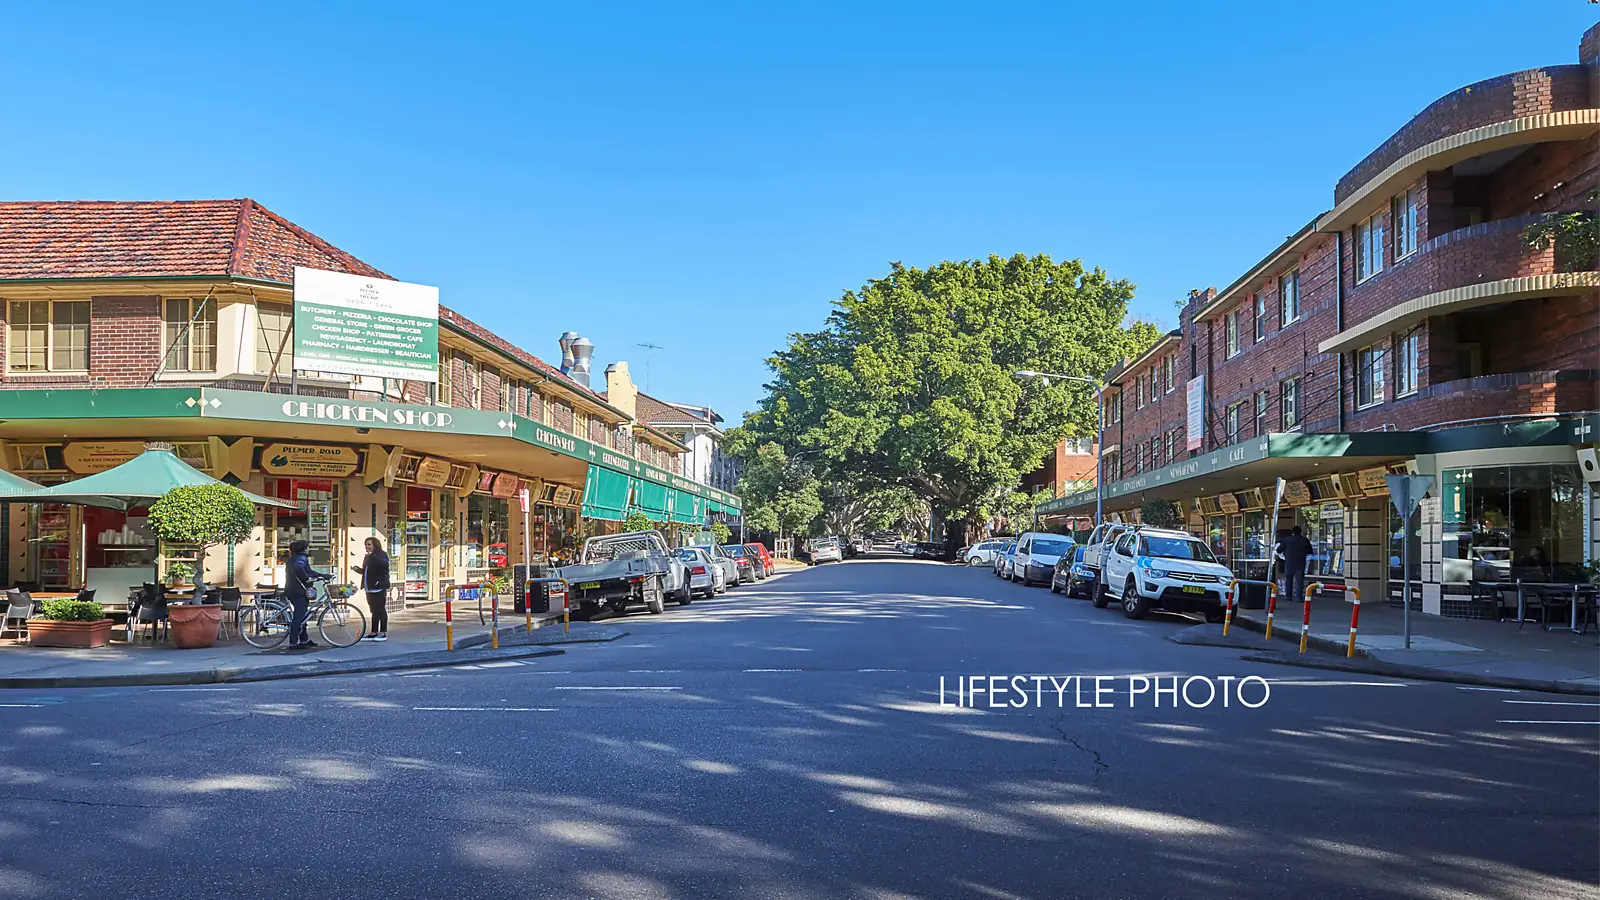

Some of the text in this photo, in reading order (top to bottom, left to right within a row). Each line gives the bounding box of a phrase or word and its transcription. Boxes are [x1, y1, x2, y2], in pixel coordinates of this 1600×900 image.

[301, 306, 336, 316] BUTCHERY
[343, 311, 372, 320] PIZZERIA
[378, 316, 416, 326] CHOCOLATE
[314, 316, 345, 325] GENERAL
[346, 320, 368, 328] STORE
[312, 324, 342, 332] CHICKEN
[366, 330, 402, 340] PATISSERIE
[302, 340, 432, 359] PHARMACY HAIRDRESSER BEAUTICIAN
[320, 334, 416, 349] NEWSAGENCY LAUNDROMAT
[282, 400, 453, 428] CHICKEN SHOP
[536, 428, 576, 452] CHICKEN SHOP
[1230, 447, 1244, 462] CAFE
